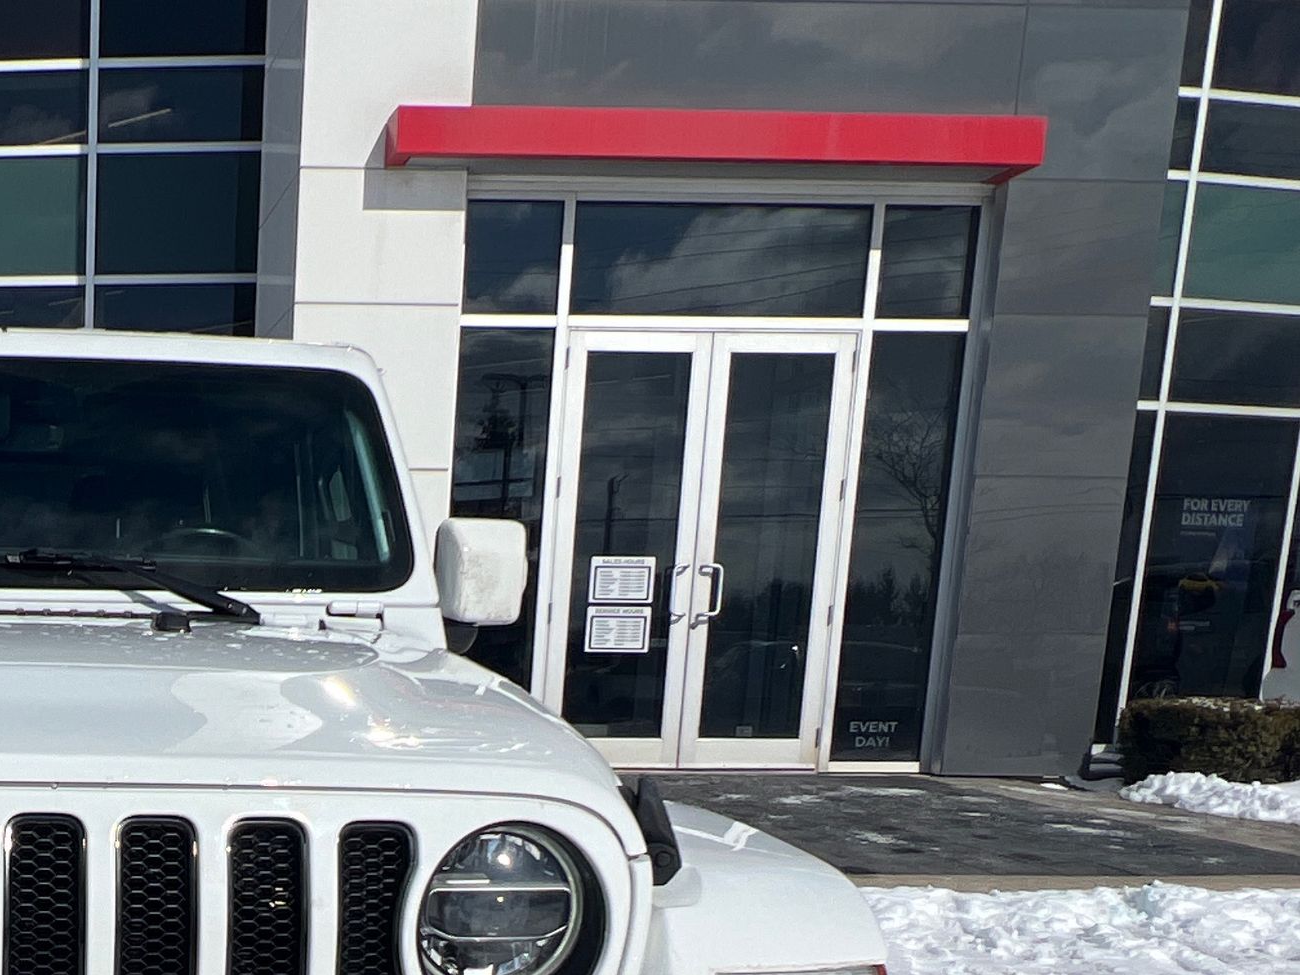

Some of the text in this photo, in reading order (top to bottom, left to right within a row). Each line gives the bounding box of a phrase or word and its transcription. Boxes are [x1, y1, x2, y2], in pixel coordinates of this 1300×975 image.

[1183, 498, 1251, 512] FOR EVERY
[1181, 512, 1244, 527] DISTANCE
[849, 721, 898, 733] EVENT
[855, 735, 890, 748] DAY!
